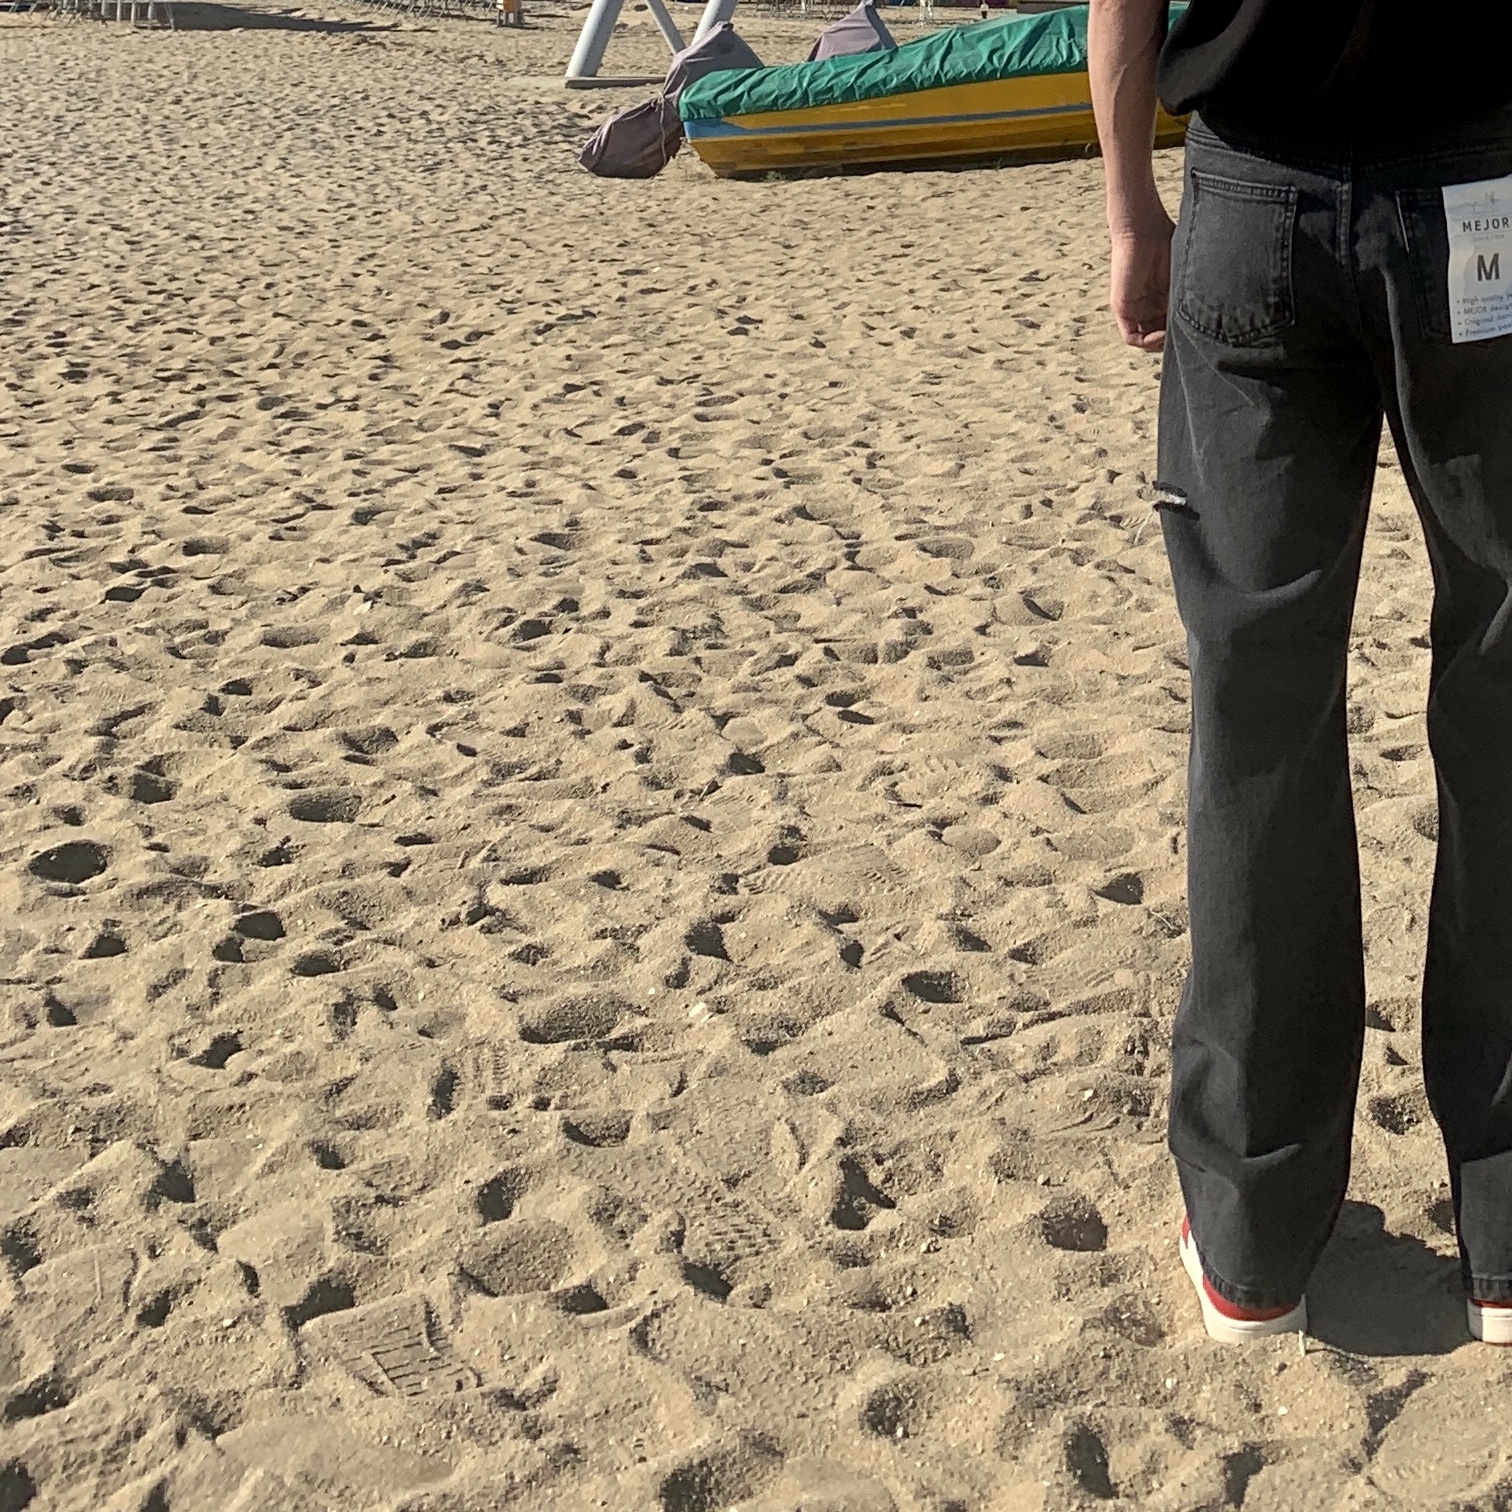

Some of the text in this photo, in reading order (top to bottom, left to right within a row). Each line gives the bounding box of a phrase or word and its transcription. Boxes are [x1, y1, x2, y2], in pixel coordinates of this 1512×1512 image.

[1462, 217, 1510, 233] MEJOR
[1477, 253, 1500, 282] M
[1463, 306, 1487, 315] MEJOR
